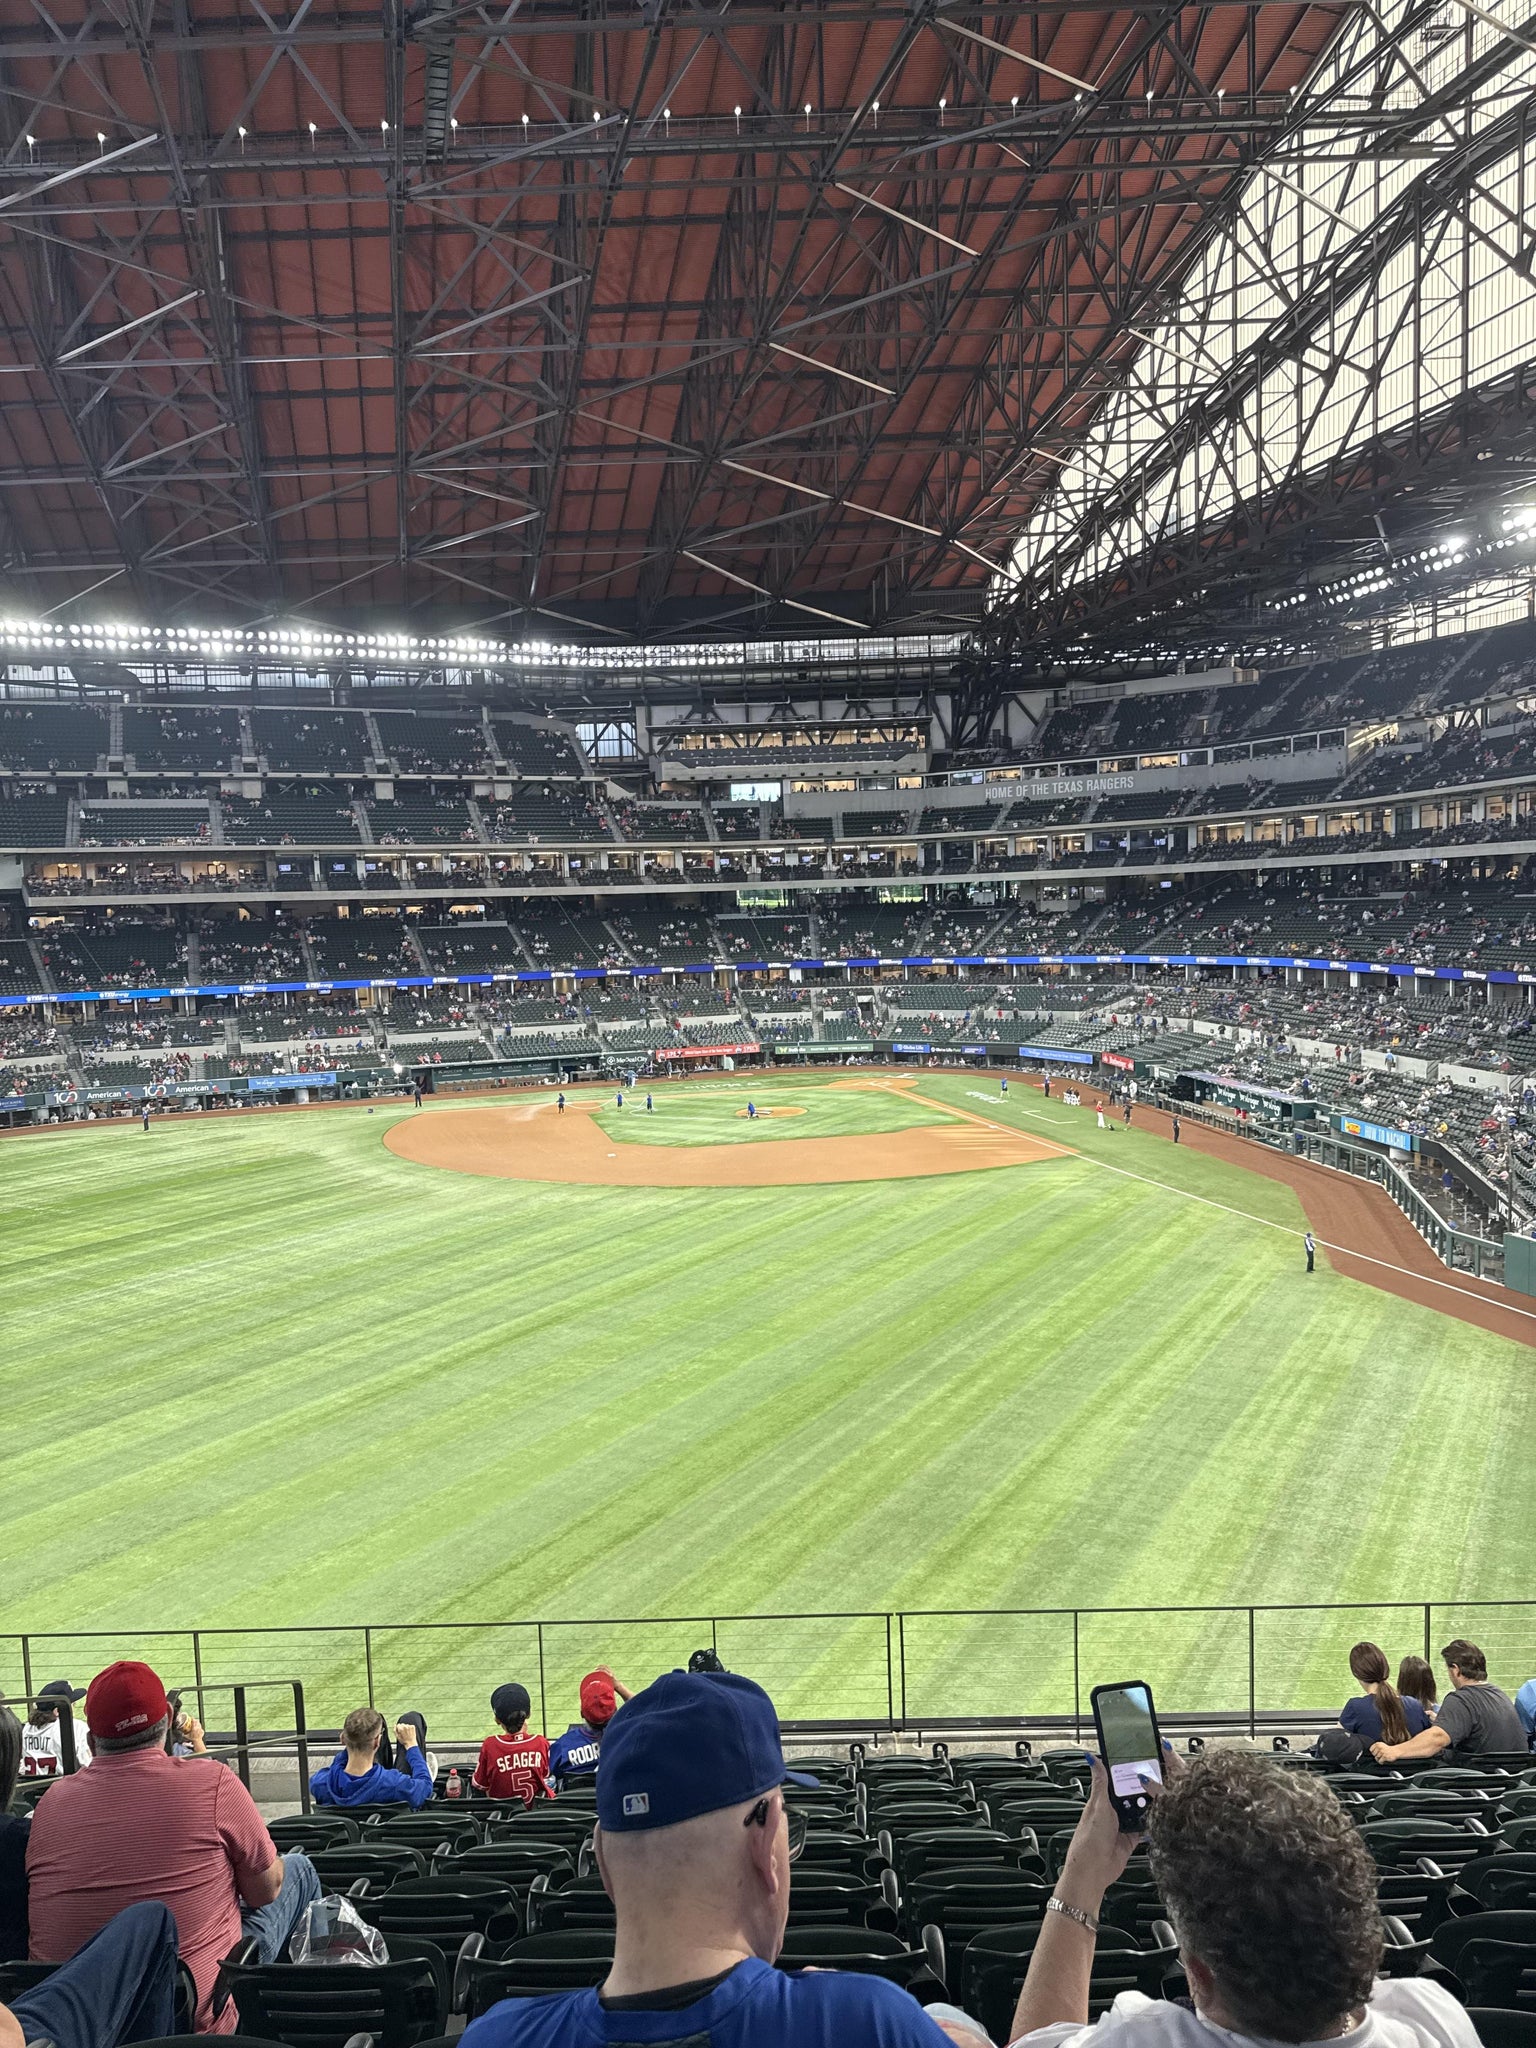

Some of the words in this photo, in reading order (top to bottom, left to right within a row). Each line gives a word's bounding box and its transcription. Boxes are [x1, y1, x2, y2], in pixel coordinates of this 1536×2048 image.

[985, 786, 1013, 799] HOME
[1016, 785, 1029, 797] OF
[1031, 783, 1049, 795] THE
[1051, 780, 1083, 794] TEXAS
[1086, 776, 1134, 791] RANGERS
[86, 1091, 122, 1099] American
[175, 1085, 209, 1093] American
[24, 1736, 51, 1751] TROUT
[497, 1751, 542, 1772] SEAGER
[511, 1769, 535, 1805] 5
